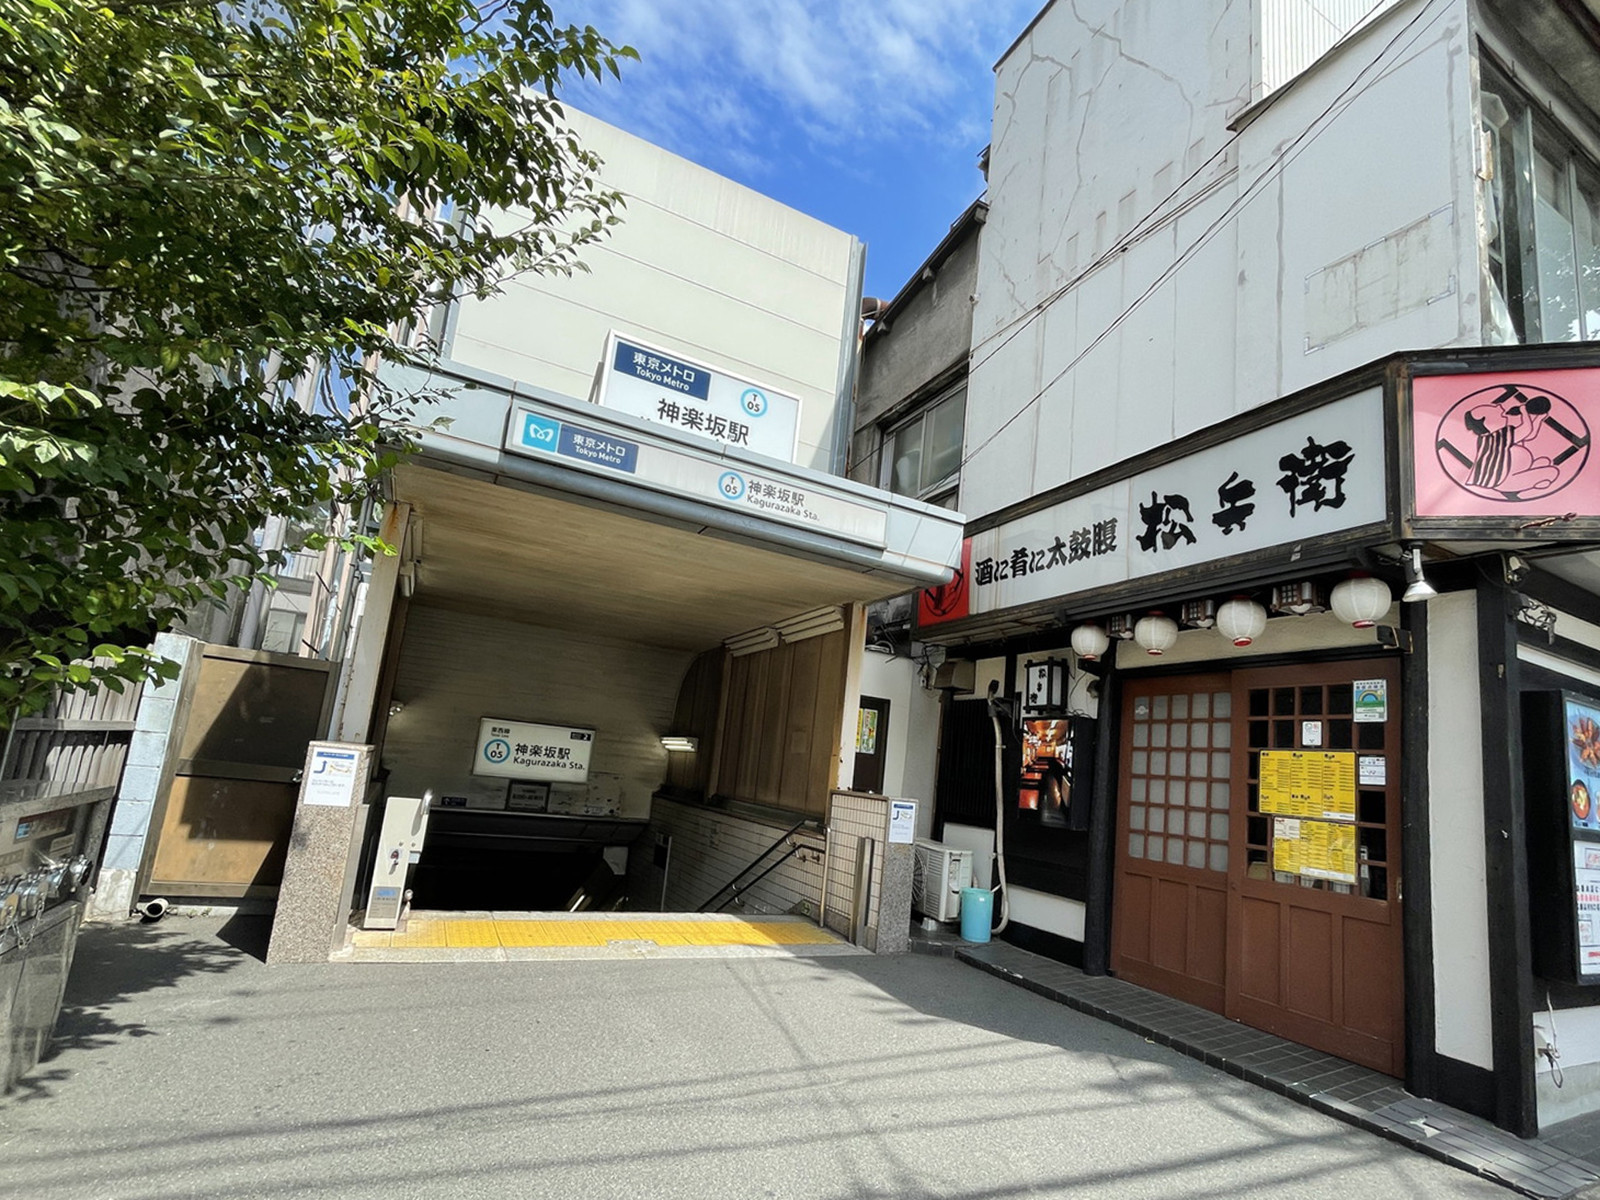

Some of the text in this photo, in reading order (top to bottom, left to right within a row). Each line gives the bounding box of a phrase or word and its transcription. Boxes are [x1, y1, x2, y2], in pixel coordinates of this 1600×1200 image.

[632, 351, 696, 383] 東京メトロ
[635, 366, 690, 391] Tokyo Metro
[746, 401, 760, 413] 05
[752, 393, 758, 402] T
[657, 397, 749, 446] 神楽坂駅
[572, 433, 626, 457] 東京メトロ
[574, 445, 622, 464] Tokyo Metro
[724, 484, 738, 495] 05
[730, 476, 736, 484] T
[748, 480, 805, 507] 神楽坂駅
[747, 494, 821, 521] Kagurazaka Sta.
[974, 517, 1118, 586] 酒に肴に太鼓腹
[490, 750, 503, 759] 05
[514, 742, 571, 761] 神楽坂駅
[513, 756, 586, 771] Kagurazaka Sta.
